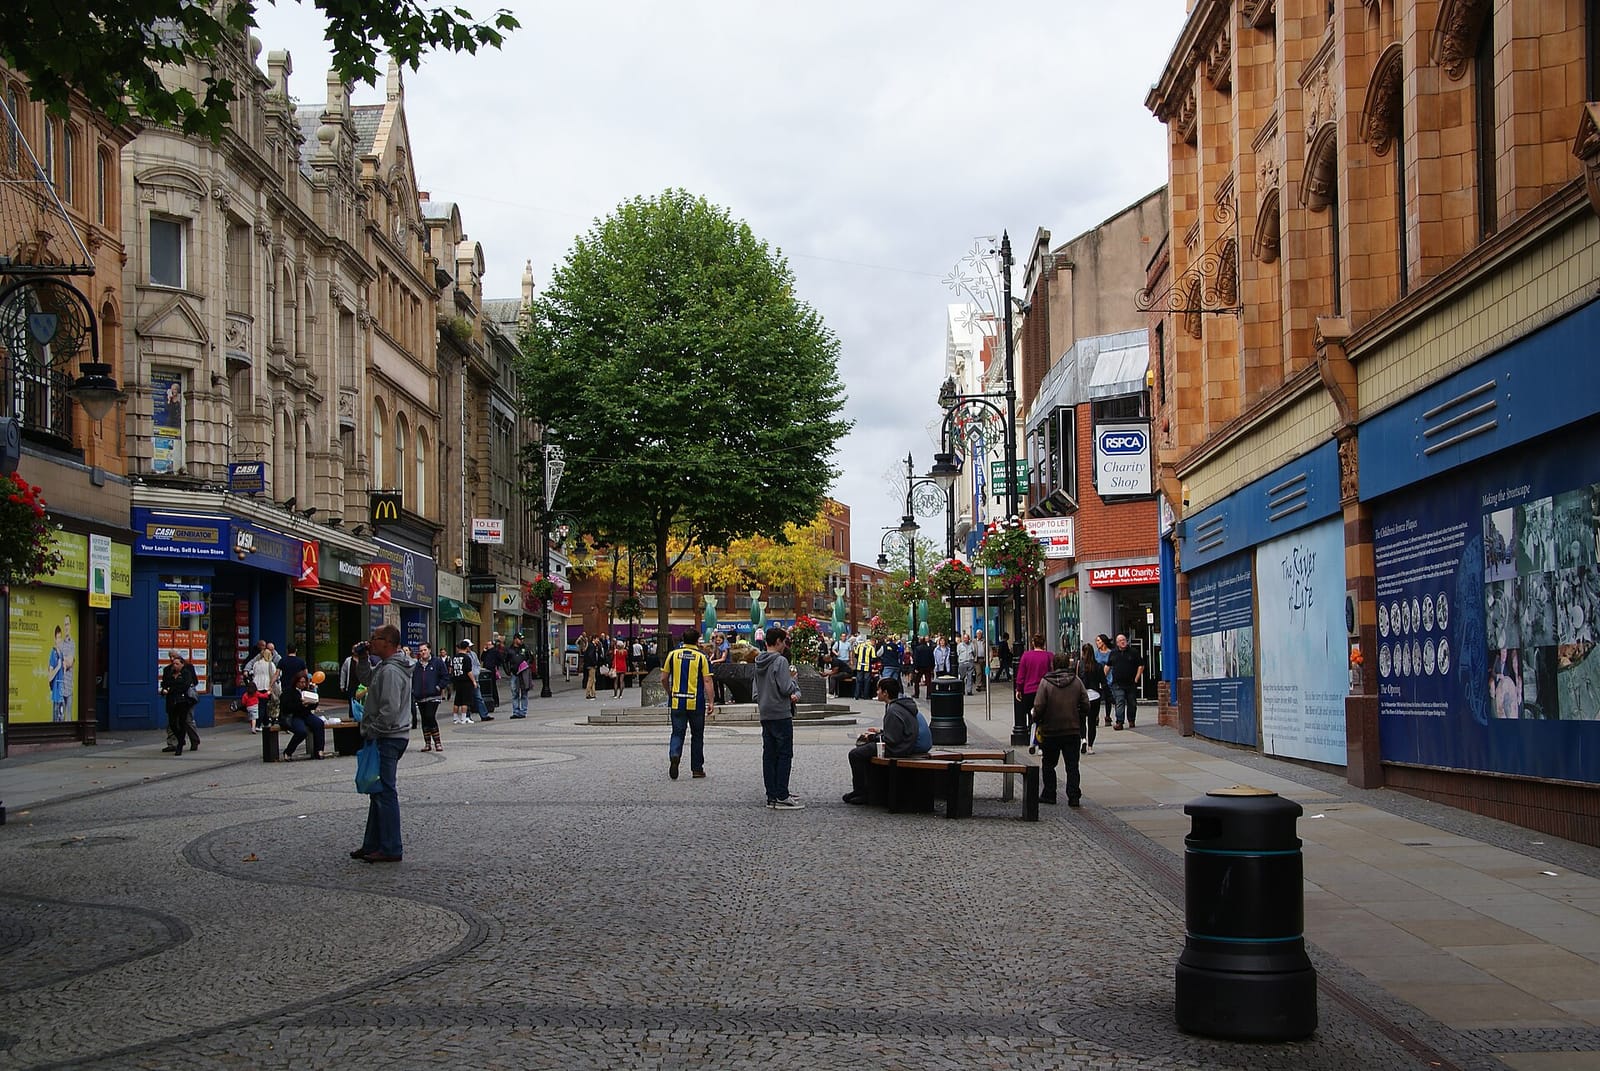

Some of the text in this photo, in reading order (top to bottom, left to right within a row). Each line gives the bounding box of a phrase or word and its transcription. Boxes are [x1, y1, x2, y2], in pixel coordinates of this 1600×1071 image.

[1106, 437, 1141, 448] RSPCA
[1104, 461, 1146, 474] Charity
[1110, 476, 1139, 489] Shop
[155, 528, 176, 536] CASH
[237, 530, 254, 549] CASH
[1281, 544, 1316, 580] The River
[339, 560, 364, 578] McDonald's
[1094, 570, 1116, 580] DAPP
[1118, 568, 1130, 578] UK
[1131, 568, 1154, 577] Charity
[111, 571, 130, 586] stering
